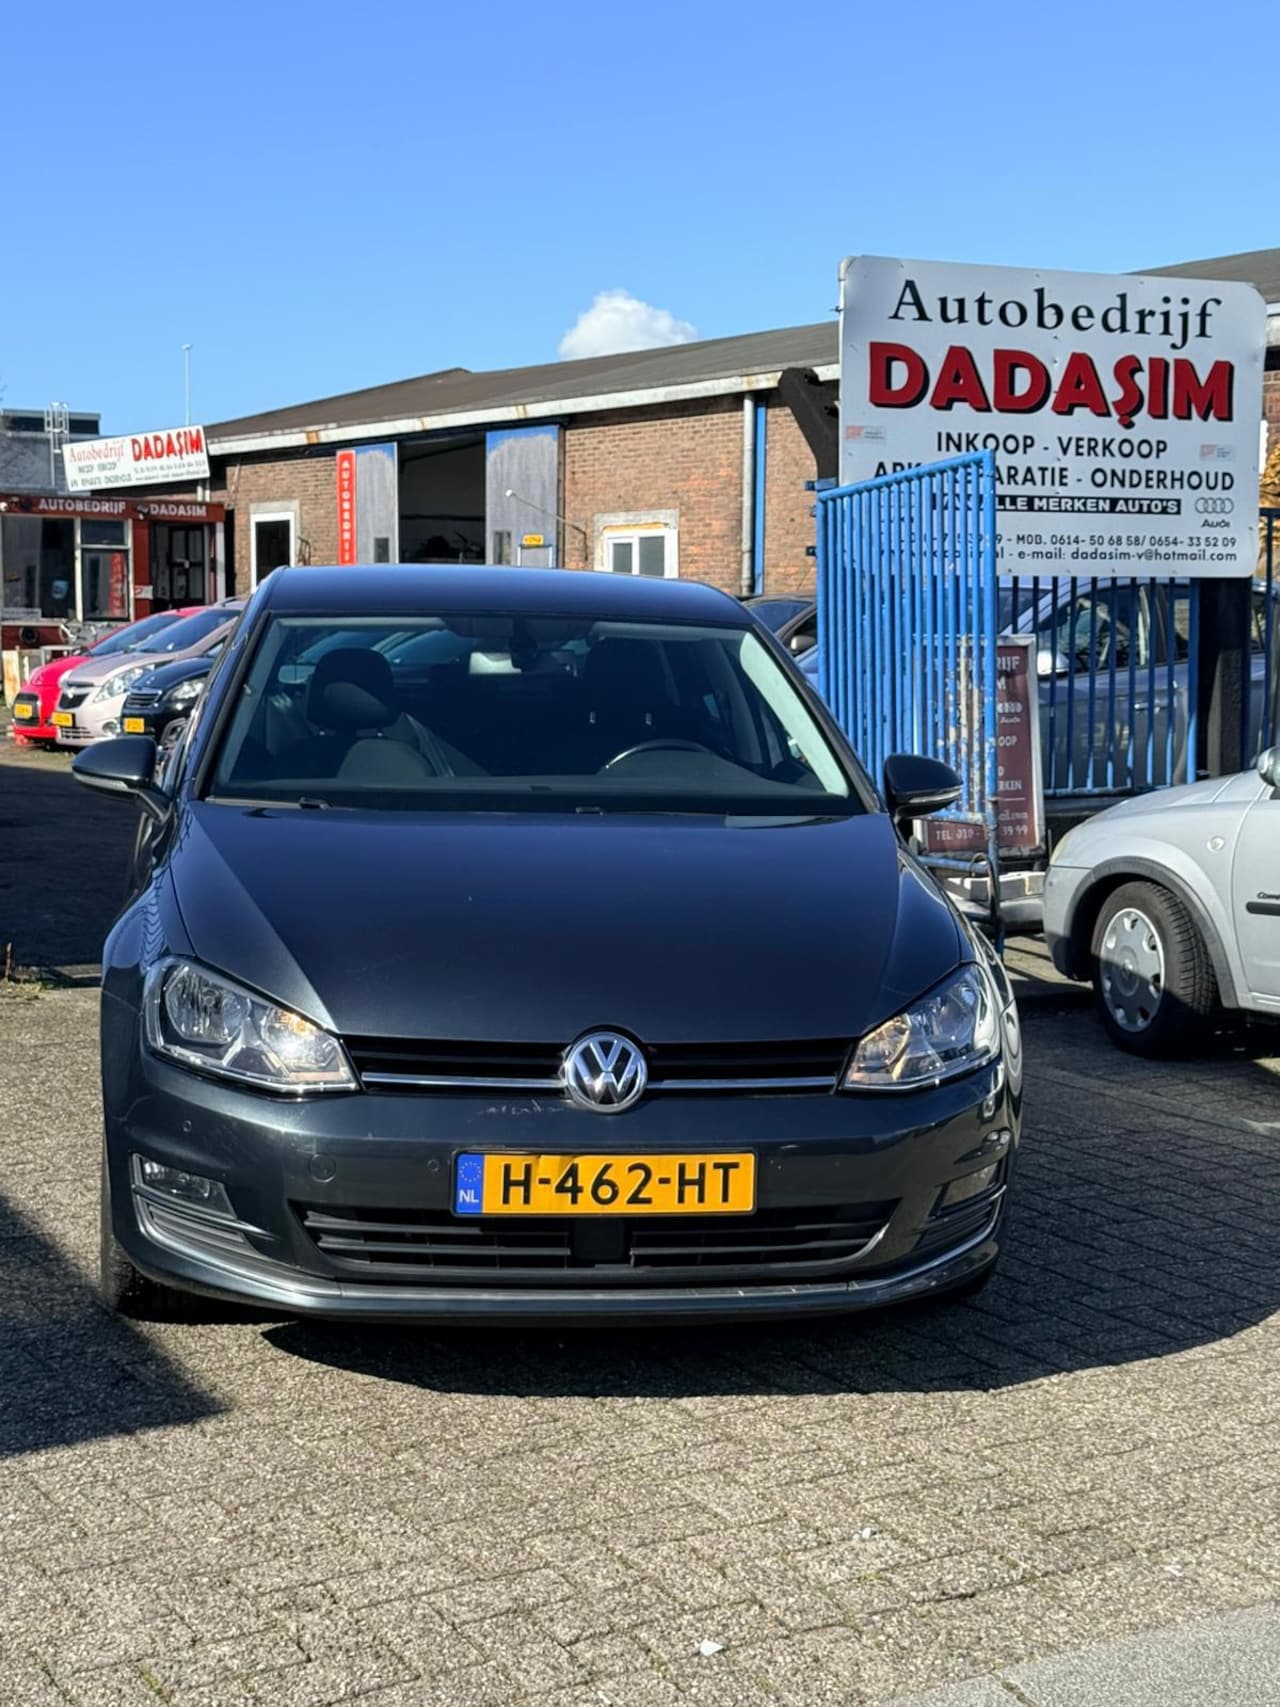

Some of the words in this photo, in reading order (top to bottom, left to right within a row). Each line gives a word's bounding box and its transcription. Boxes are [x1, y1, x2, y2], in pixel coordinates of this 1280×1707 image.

[888, 280, 1222, 349] Autobedrijf
[869, 341, 1234, 428] DADAŞIM
[937, 431, 1034, 454] INKOOP
[1058, 436, 1168, 460] VERKOOP
[1091, 468, 1235, 491] ONDERHOUD
[39, 498, 126, 514] AUTOBEDRIJF
[150, 503, 207, 517] DADASIM
[994, 496, 1029, 510] LLE
[1033, 498, 1110, 512] MERKEN
[1114, 499, 1179, 513] AUTO'S
[1201, 519, 1230, 528] Audi
[1016, 534, 1047, 545] MOB.
[1089, 535, 1105, 546] 50
[1107, 535, 1123, 546] 68
[1188, 537, 1202, 547] 33
[1205, 537, 1219, 547] 52
[1222, 537, 1237, 548] 09
[1018, 547, 1067, 560] e-mail:
[502, 1161, 740, 1205] H-462-HT
[459, 1190, 479, 1203] NL
